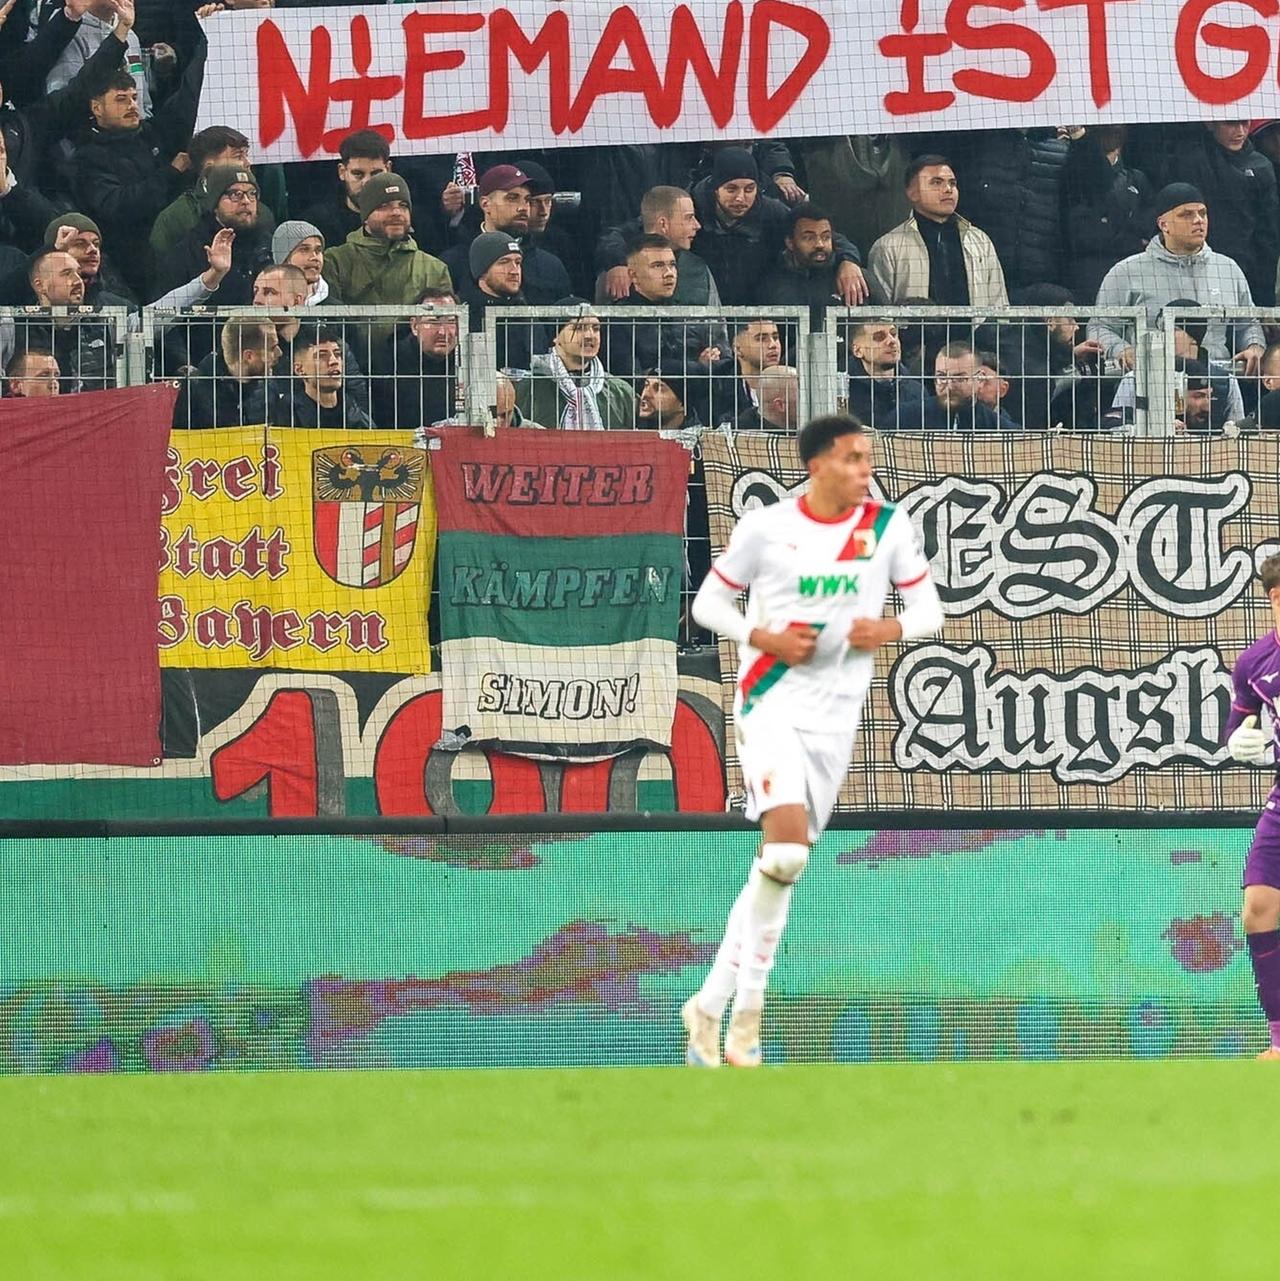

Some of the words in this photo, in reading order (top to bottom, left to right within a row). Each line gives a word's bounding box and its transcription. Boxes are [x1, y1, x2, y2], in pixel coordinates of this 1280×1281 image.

[257, 1, 832, 158] NIEMAND
[458, 462, 654, 507] WEITER
[450, 561, 671, 610] KÄMPFEN
[797, 574, 861, 598] WWK
[477, 671, 642, 720] SIMON!
